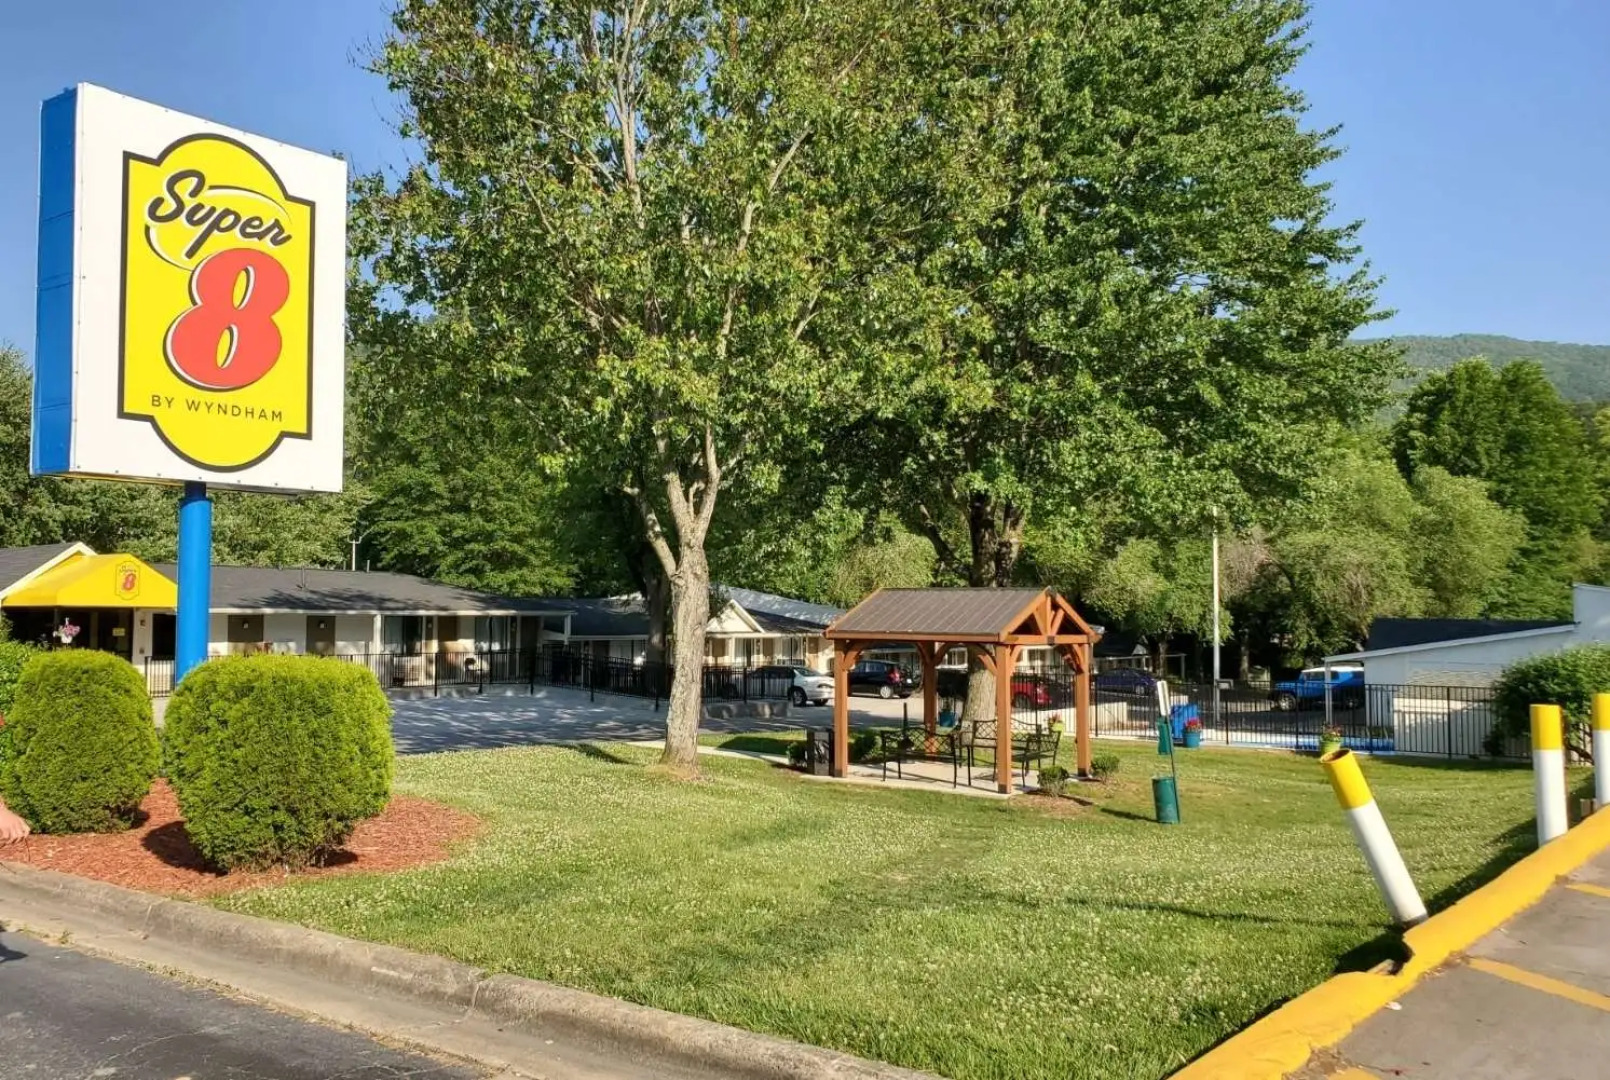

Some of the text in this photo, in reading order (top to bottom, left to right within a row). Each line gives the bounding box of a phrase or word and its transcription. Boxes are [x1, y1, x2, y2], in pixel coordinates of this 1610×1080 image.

[147, 168, 292, 260] Super
[163, 247, 290, 393] 8
[151, 394, 283, 422] BY WYNDHAM
